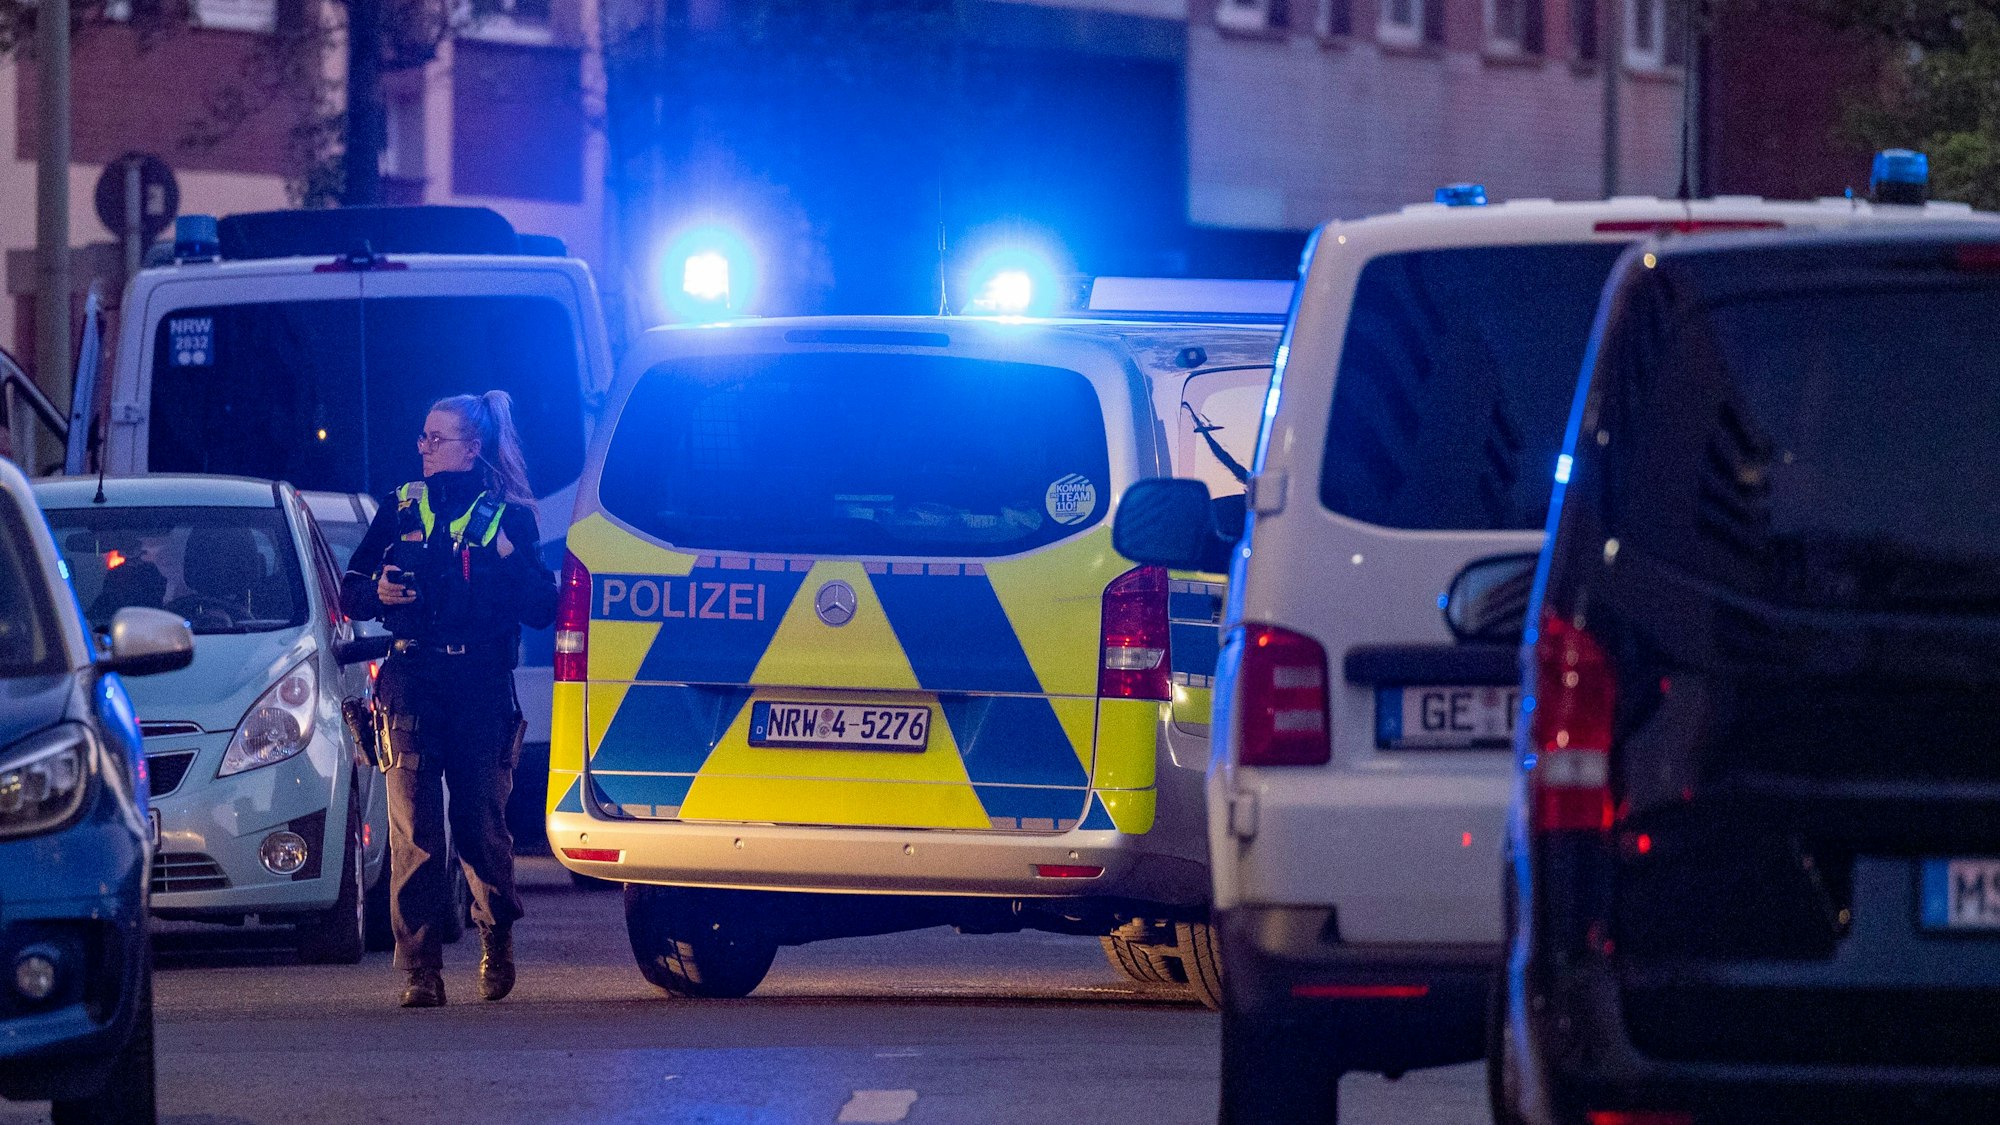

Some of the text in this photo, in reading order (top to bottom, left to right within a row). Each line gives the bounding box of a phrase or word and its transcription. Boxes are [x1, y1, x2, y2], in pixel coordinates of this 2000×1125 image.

[169, 318, 211, 334] NRW
[1056, 484, 1085, 493] KOMM
[1060, 492, 1090, 502] TEAM
[1056, 501, 1077, 511] 110!
[603, 579, 765, 621] POLIZEI
[1422, 692, 1474, 731] GE
[756, 708, 924, 741] D NRW 4-5276
